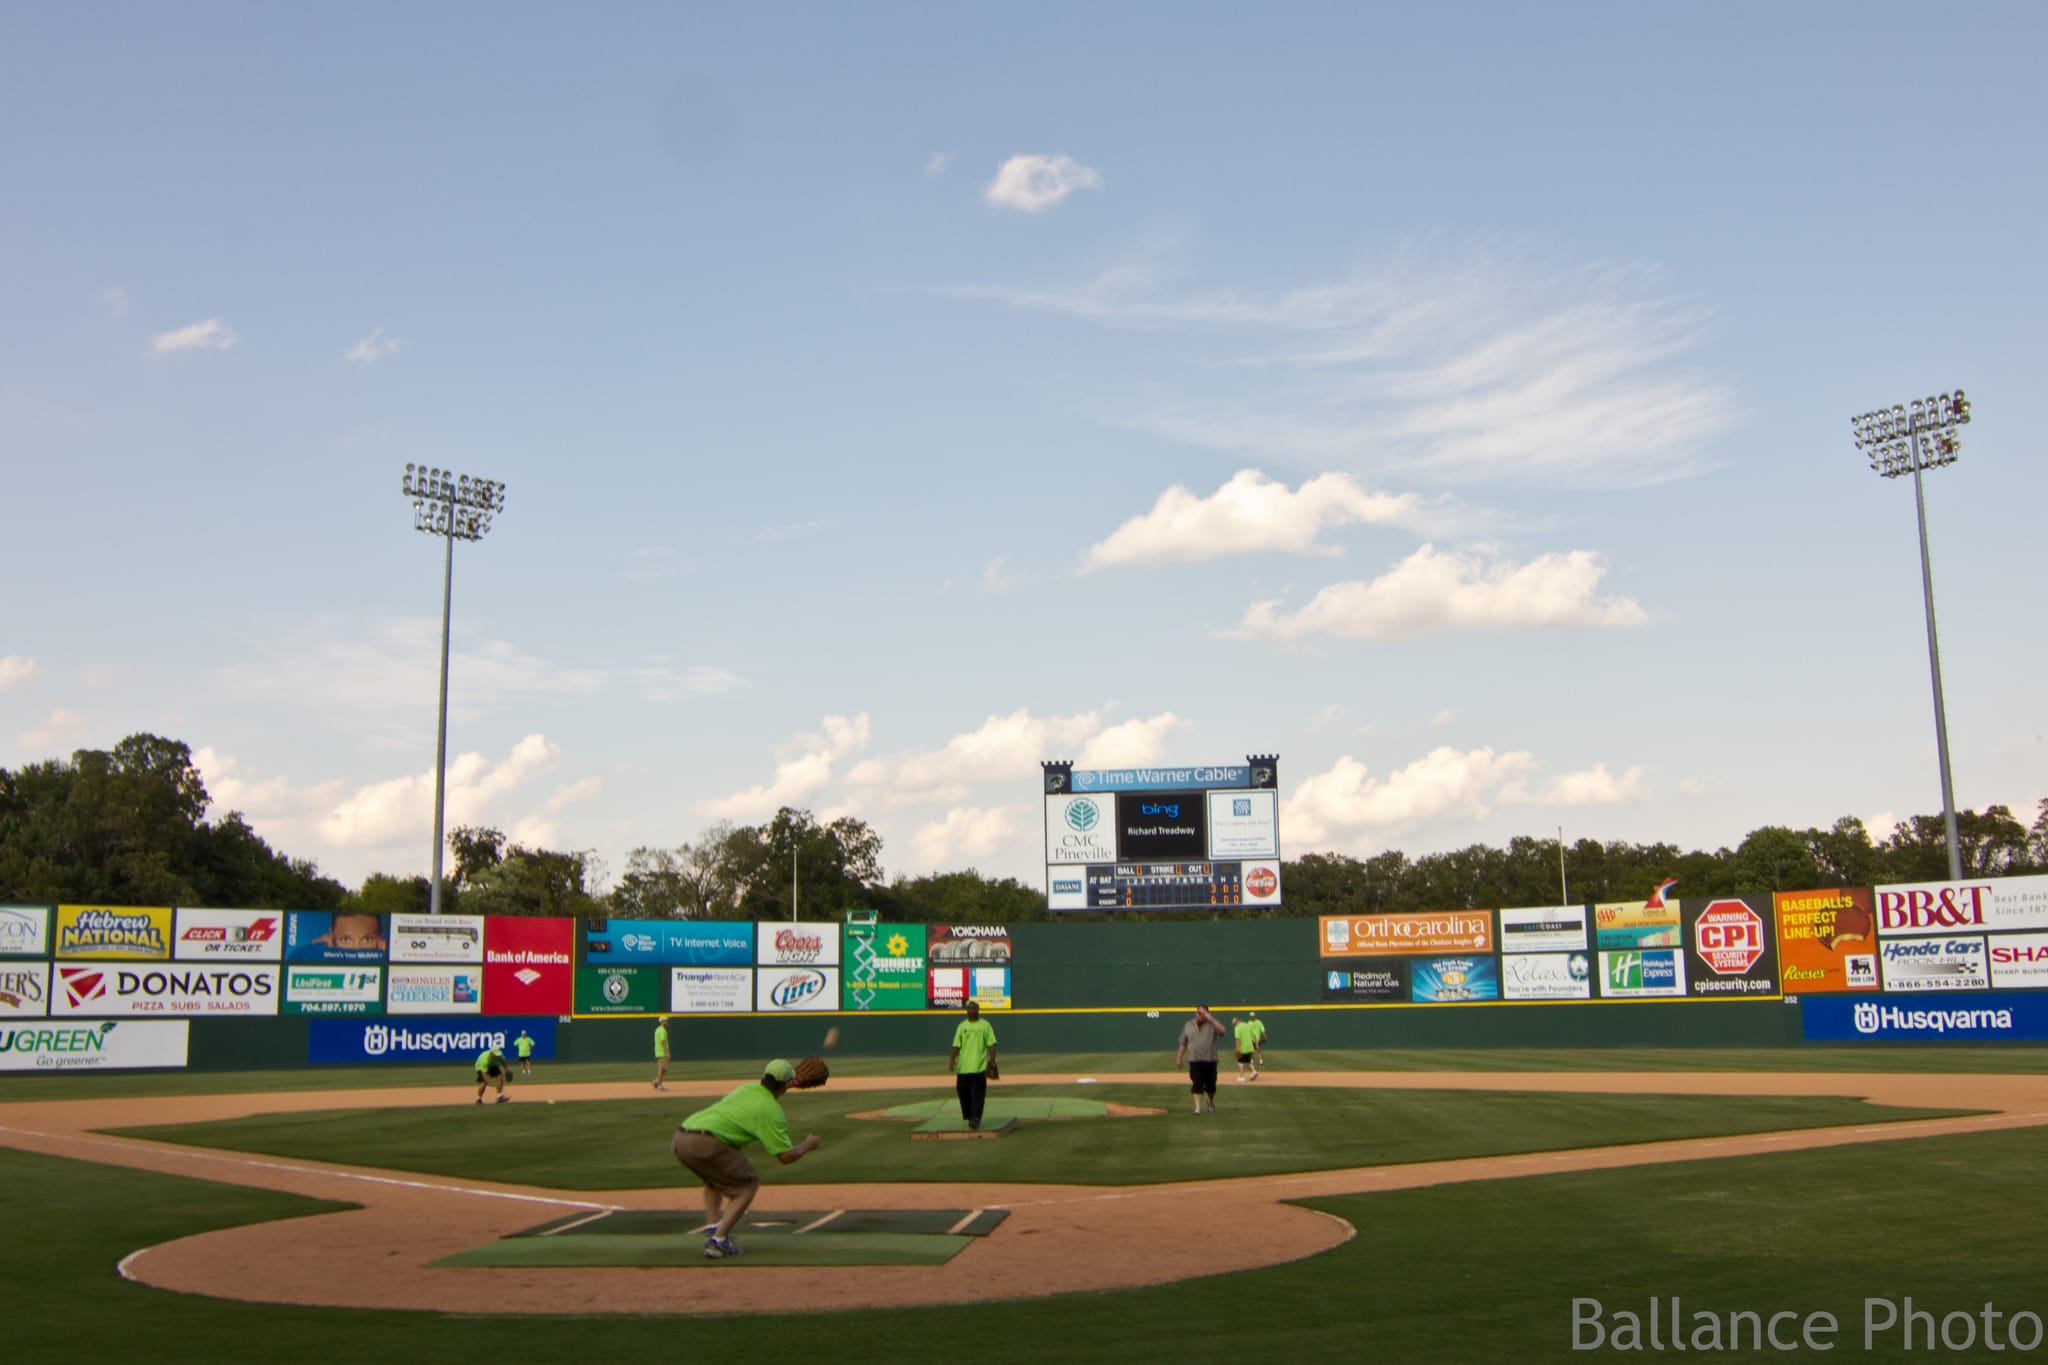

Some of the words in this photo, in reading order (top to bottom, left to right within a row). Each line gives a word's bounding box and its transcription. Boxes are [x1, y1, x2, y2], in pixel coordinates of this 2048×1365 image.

[1098, 768, 1134, 785] Time
[1136, 768, 1192, 783] Warner
[1194, 765, 1237, 782] Cable
[1141, 803, 1179, 818] bing
[1128, 826, 1157, 836] Richard
[1159, 826, 1195, 837] Treadway
[1062, 835, 1098, 847] CMC
[1055, 848, 1112, 860] Pineville
[1117, 866, 1135, 875] BALL
[1151, 865, 1174, 874] STRIKE
[1189, 864, 1202, 873] OUT
[1090, 876, 1097, 885] AT
[1100, 876, 1112, 884] BAT
[1782, 896, 1853, 911] BASEBALL'S
[1994, 895, 2017, 903] Best
[1879, 886, 1992, 929] BB&T
[1995, 907, 2024, 915] Since
[80, 911, 148, 929] Hebrew
[1707, 913, 1749, 923] WARNING
[1783, 912, 1837, 925] PERFECT
[951, 926, 1007, 936] YOKOHAMA
[1355, 915, 1485, 938] OrthoCarolina
[65, 928, 160, 947] NATIONAL
[189, 930, 223, 939] CLICK
[251, 930, 264, 939] IT
[1701, 925, 1757, 949] CPI
[1784, 927, 1835, 940] LINE-UP!
[776, 929, 821, 951] Coors
[205, 944, 220, 952] OR
[1883, 941, 1941, 961] Honda
[1945, 940, 1982, 954] Cars
[487, 951, 514, 962] Bank
[515, 951, 525, 962] of
[527, 952, 568, 963] America
[776, 951, 819, 963] LIGHT
[1712, 951, 1748, 961] SECURITY
[1897, 957, 1935, 966] ROCK
[1939, 956, 1968, 964] HILL
[1714, 959, 1748, 968] SYSTEMS
[677, 972, 713, 983] Triangle
[1353, 972, 1391, 980] Piedmont
[1644, 968, 1673, 979] Express
[117, 972, 271, 996] DONATOS
[296, 978, 331, 988] UniFirst
[1353, 979, 1381, 988] Natural
[1384, 979, 1400, 988] Gas
[1695, 979, 1771, 994] cpisecurity.com
[782, 979, 818, 1006] Lite
[934, 989, 963, 998] Million
[132, 1001, 164, 1011] PIZZA
[171, 1001, 201, 1011] SUBS
[208, 1001, 250, 1011] SALADS
[1881, 1007, 2013, 1032] Husqvarna
[390, 1029, 505, 1052] Husqvarna
[36, 1056, 53, 1066] Go
